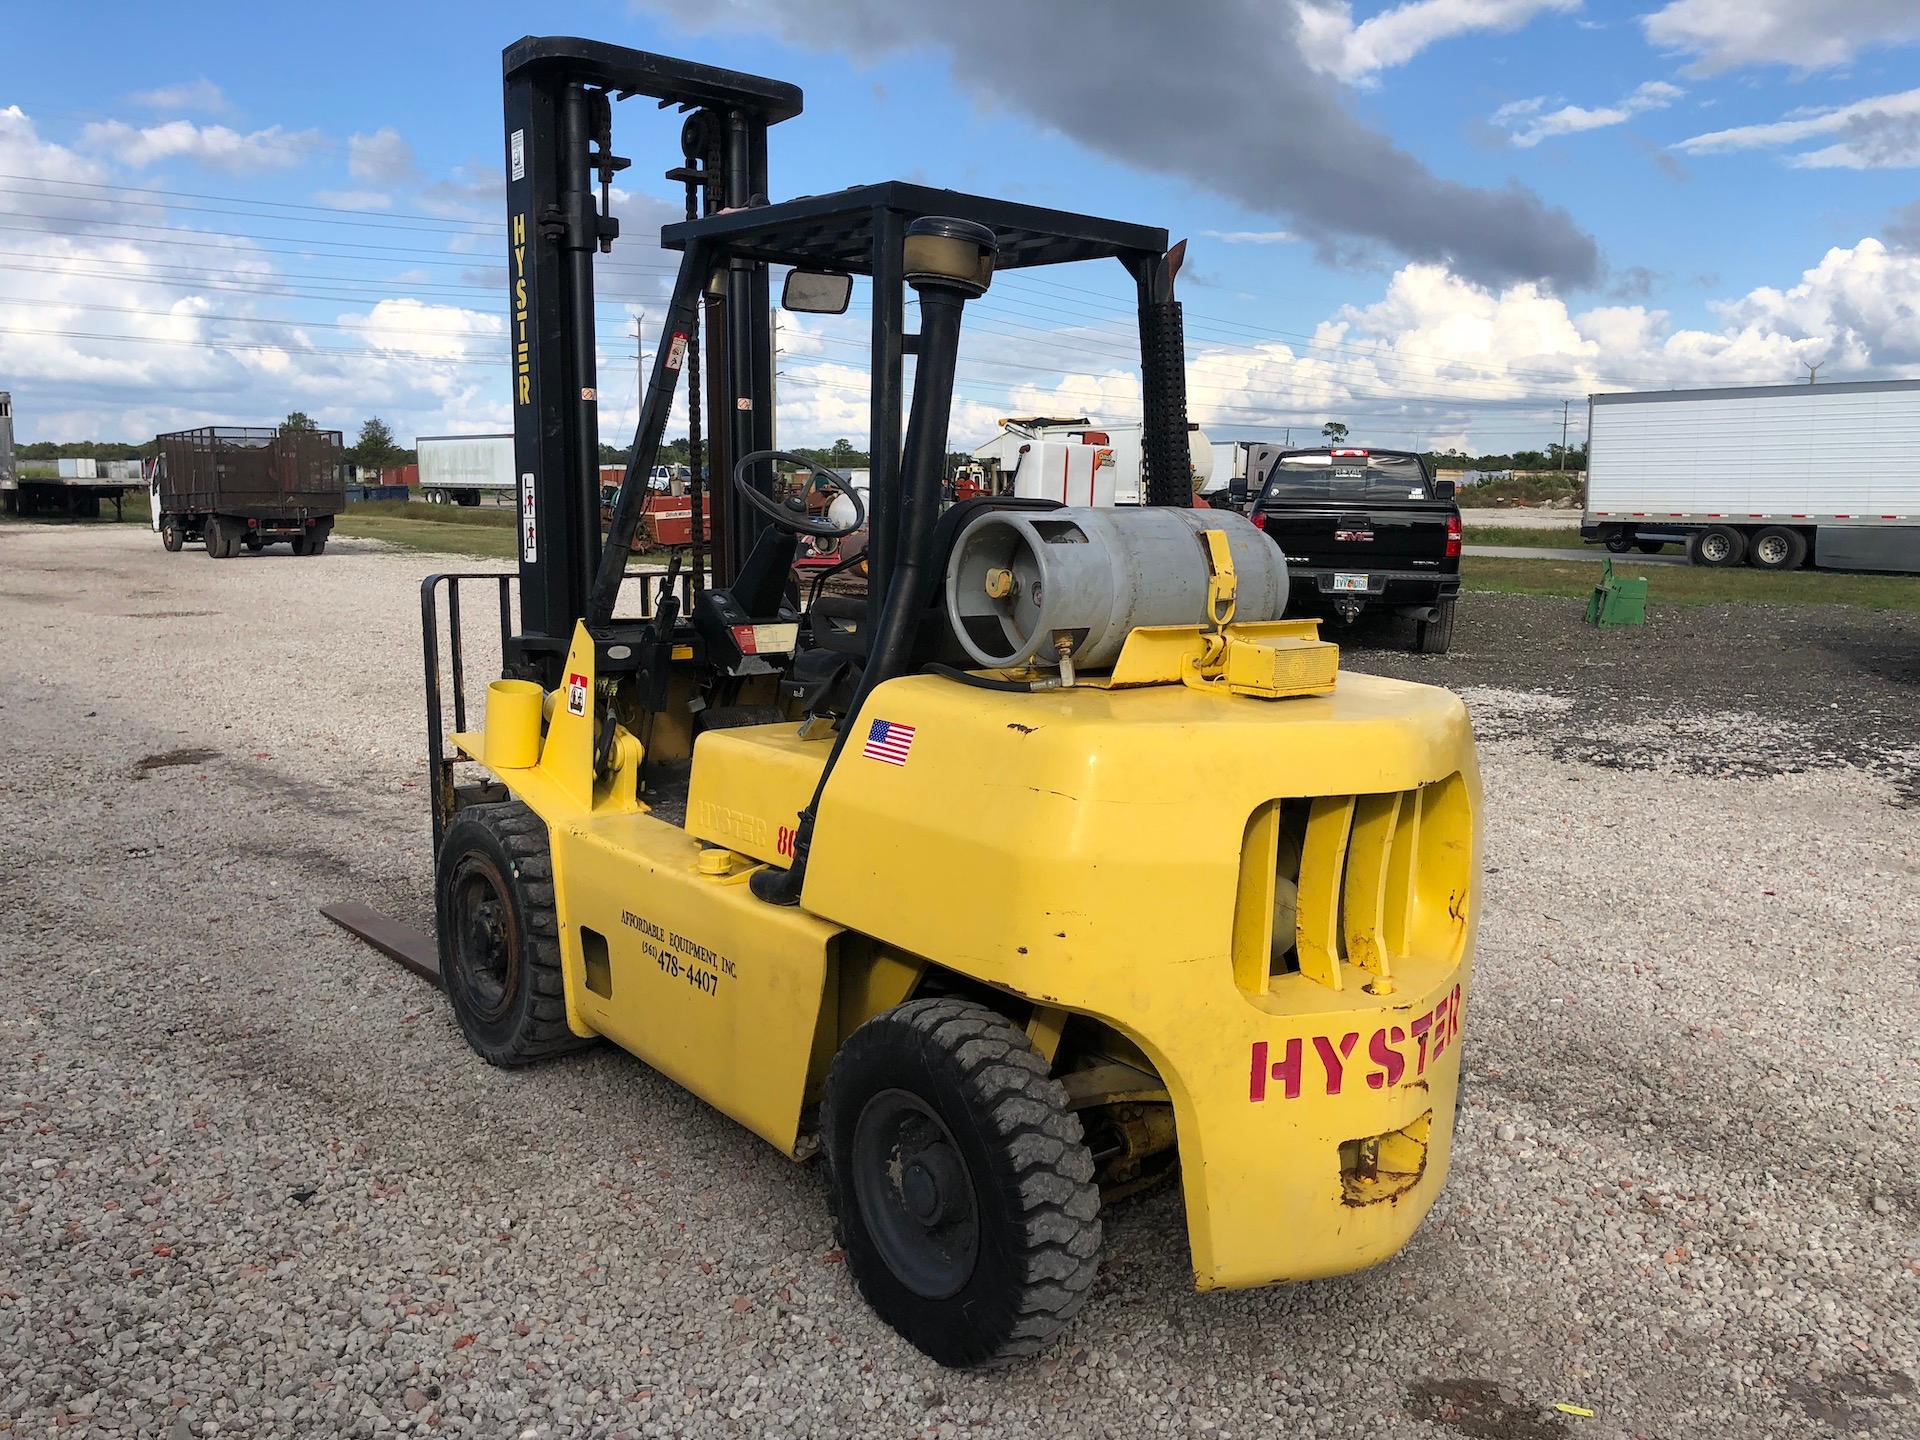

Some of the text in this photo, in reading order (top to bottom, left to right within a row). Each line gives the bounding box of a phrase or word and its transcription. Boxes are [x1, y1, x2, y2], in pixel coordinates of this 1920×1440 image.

[514, 213, 531, 405] HYSTER
[1334, 531, 1374, 541] GMC
[698, 799, 768, 847] HYSTER
[620, 909, 665, 943] AFFORDABLE
[669, 931, 718, 971] EQUIPMENT,
[1250, 983, 1462, 1103] HYSTER
